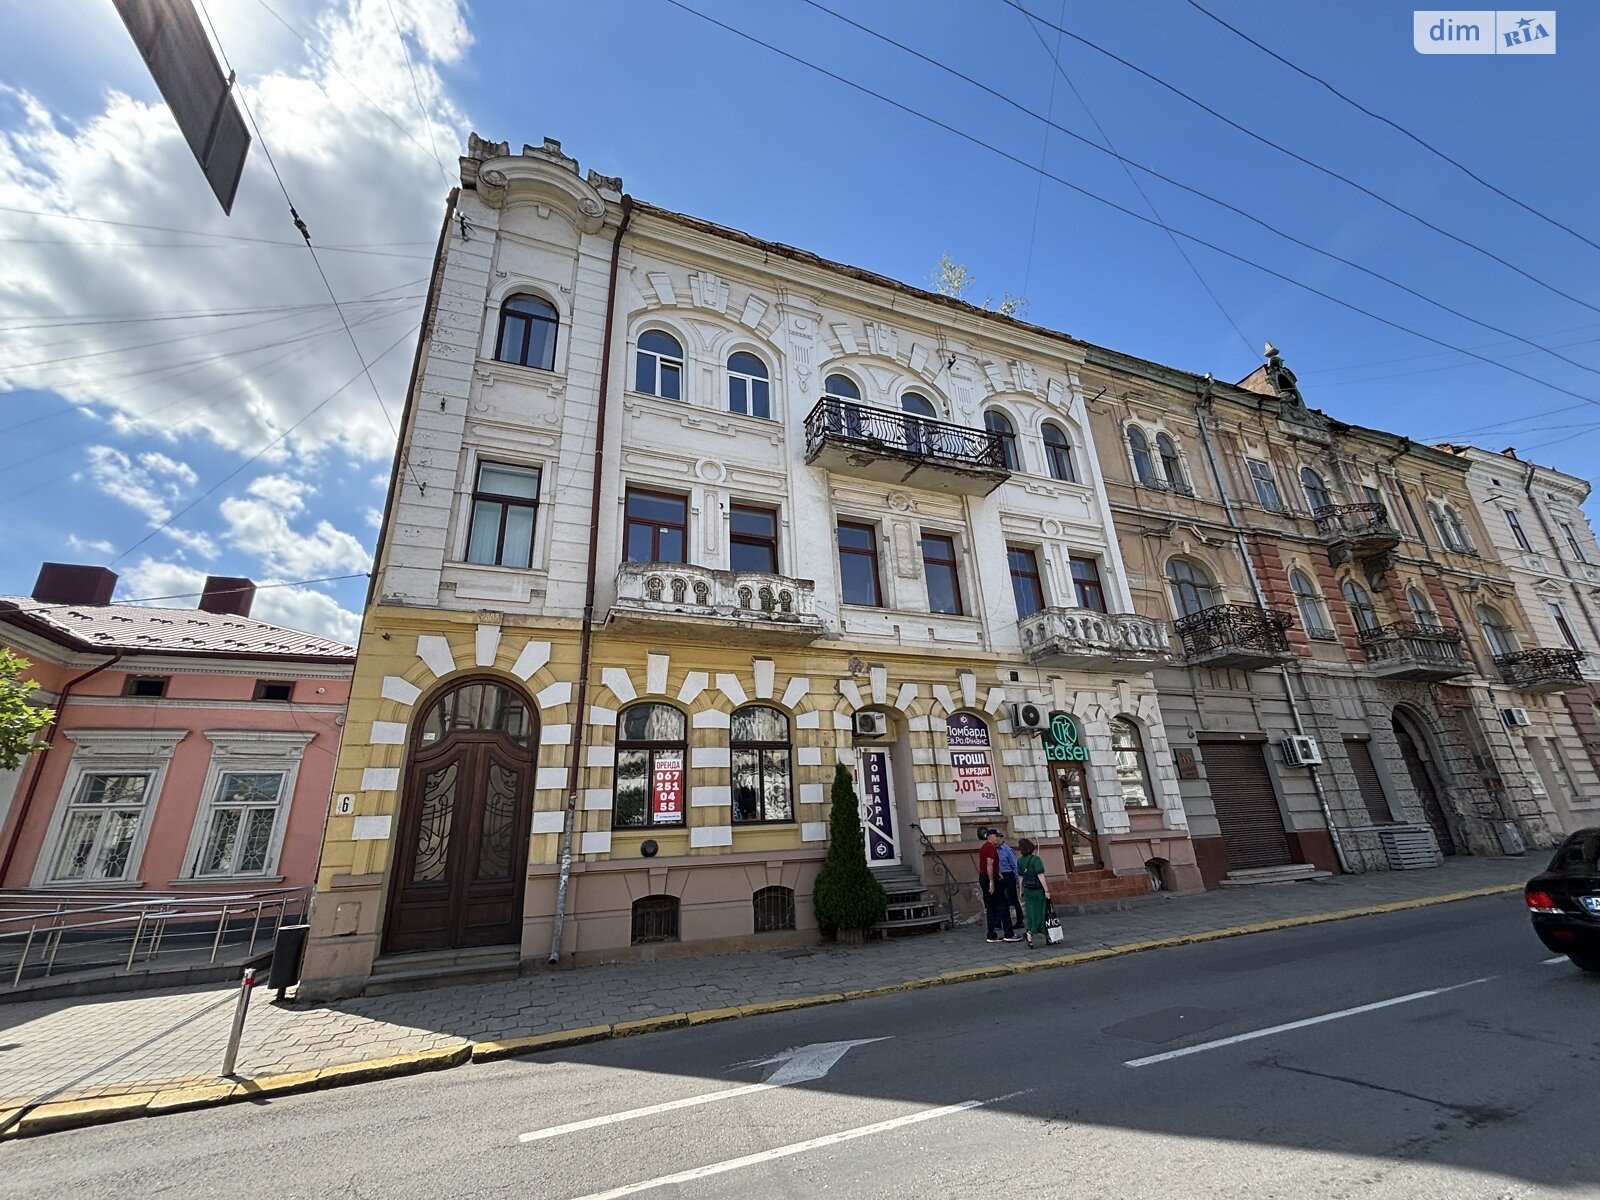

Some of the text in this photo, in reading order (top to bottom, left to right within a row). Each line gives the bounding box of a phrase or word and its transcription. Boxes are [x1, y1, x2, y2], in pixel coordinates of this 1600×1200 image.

[953, 753, 985, 766] ГРОШІ
[656, 761, 681, 770] ОРЕНДА
[656, 771, 680, 781] 067
[966, 766, 990, 776] КРЕДИТ
[656, 781, 680, 791] 251
[869, 754, 884, 826] ЛОМБАРД
[660, 792, 676, 801] 04
[342, 796, 350, 813] 6
[660, 802, 676, 811] 55
